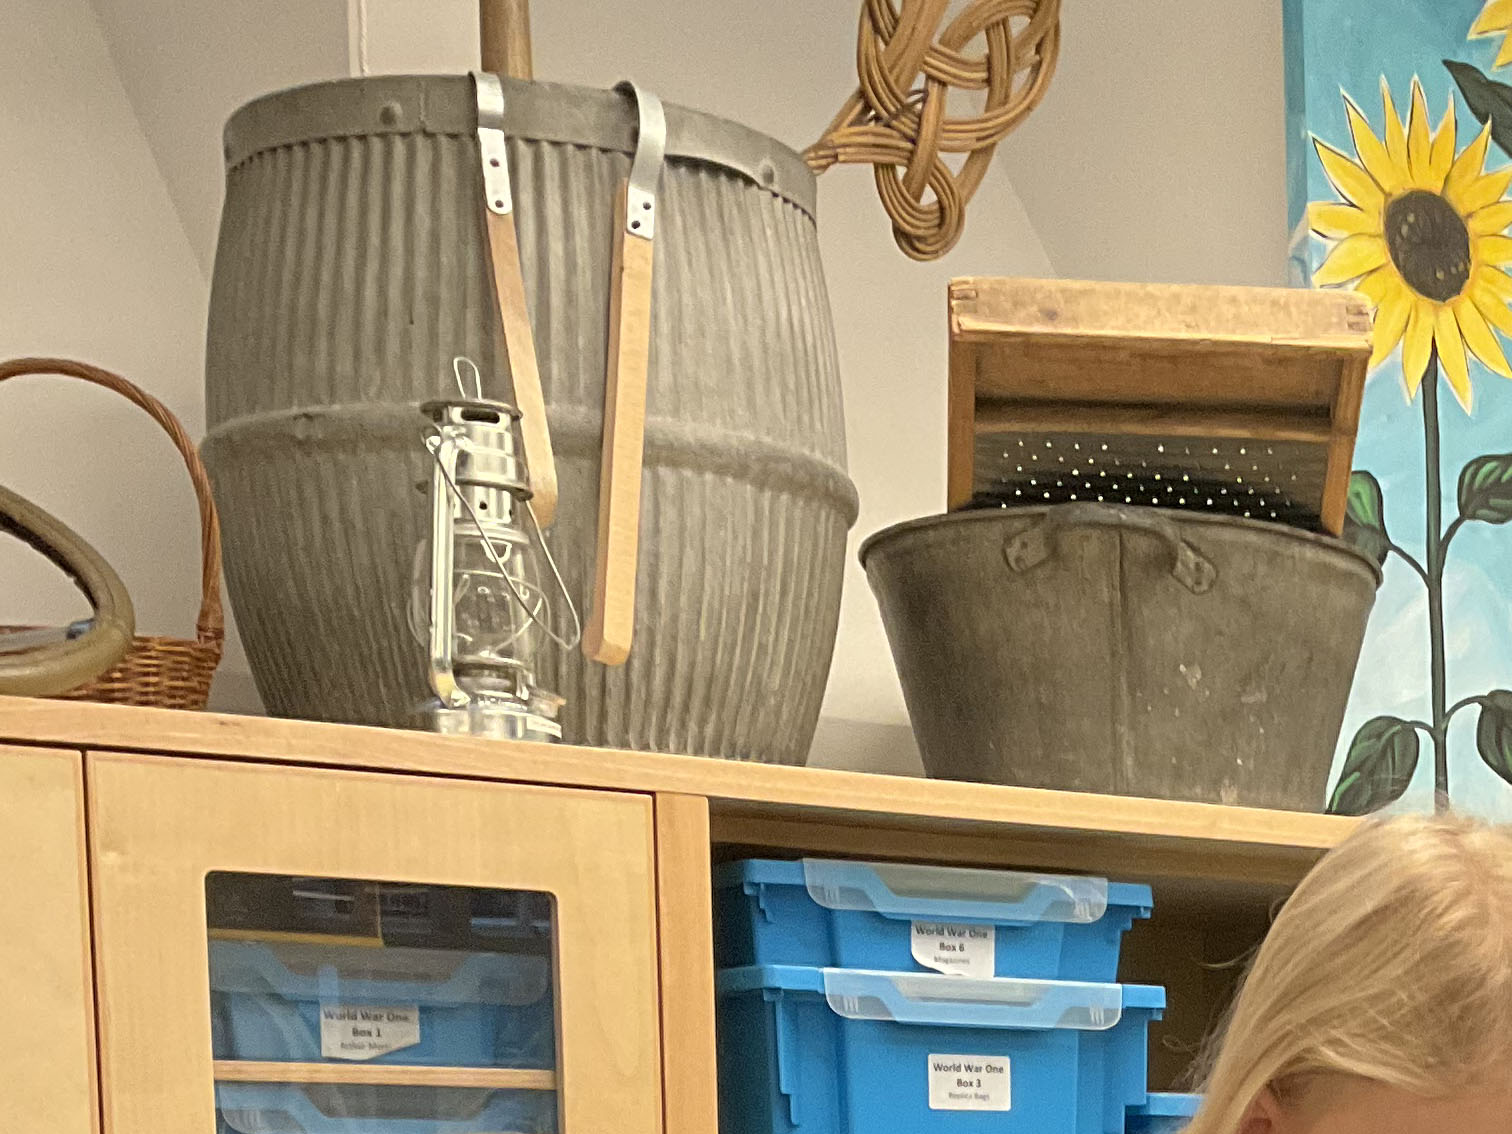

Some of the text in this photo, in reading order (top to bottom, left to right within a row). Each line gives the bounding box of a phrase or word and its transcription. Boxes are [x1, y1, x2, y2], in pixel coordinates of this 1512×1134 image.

[915, 924, 988, 938] World War One
[939, 942, 965, 952] Box 6
[322, 1008, 358, 1020] World
[360, 1009, 384, 1021] War
[352, 1027, 372, 1037] Box
[933, 1063, 1004, 1073] World War One
[956, 1078, 981, 1088] Box 3
